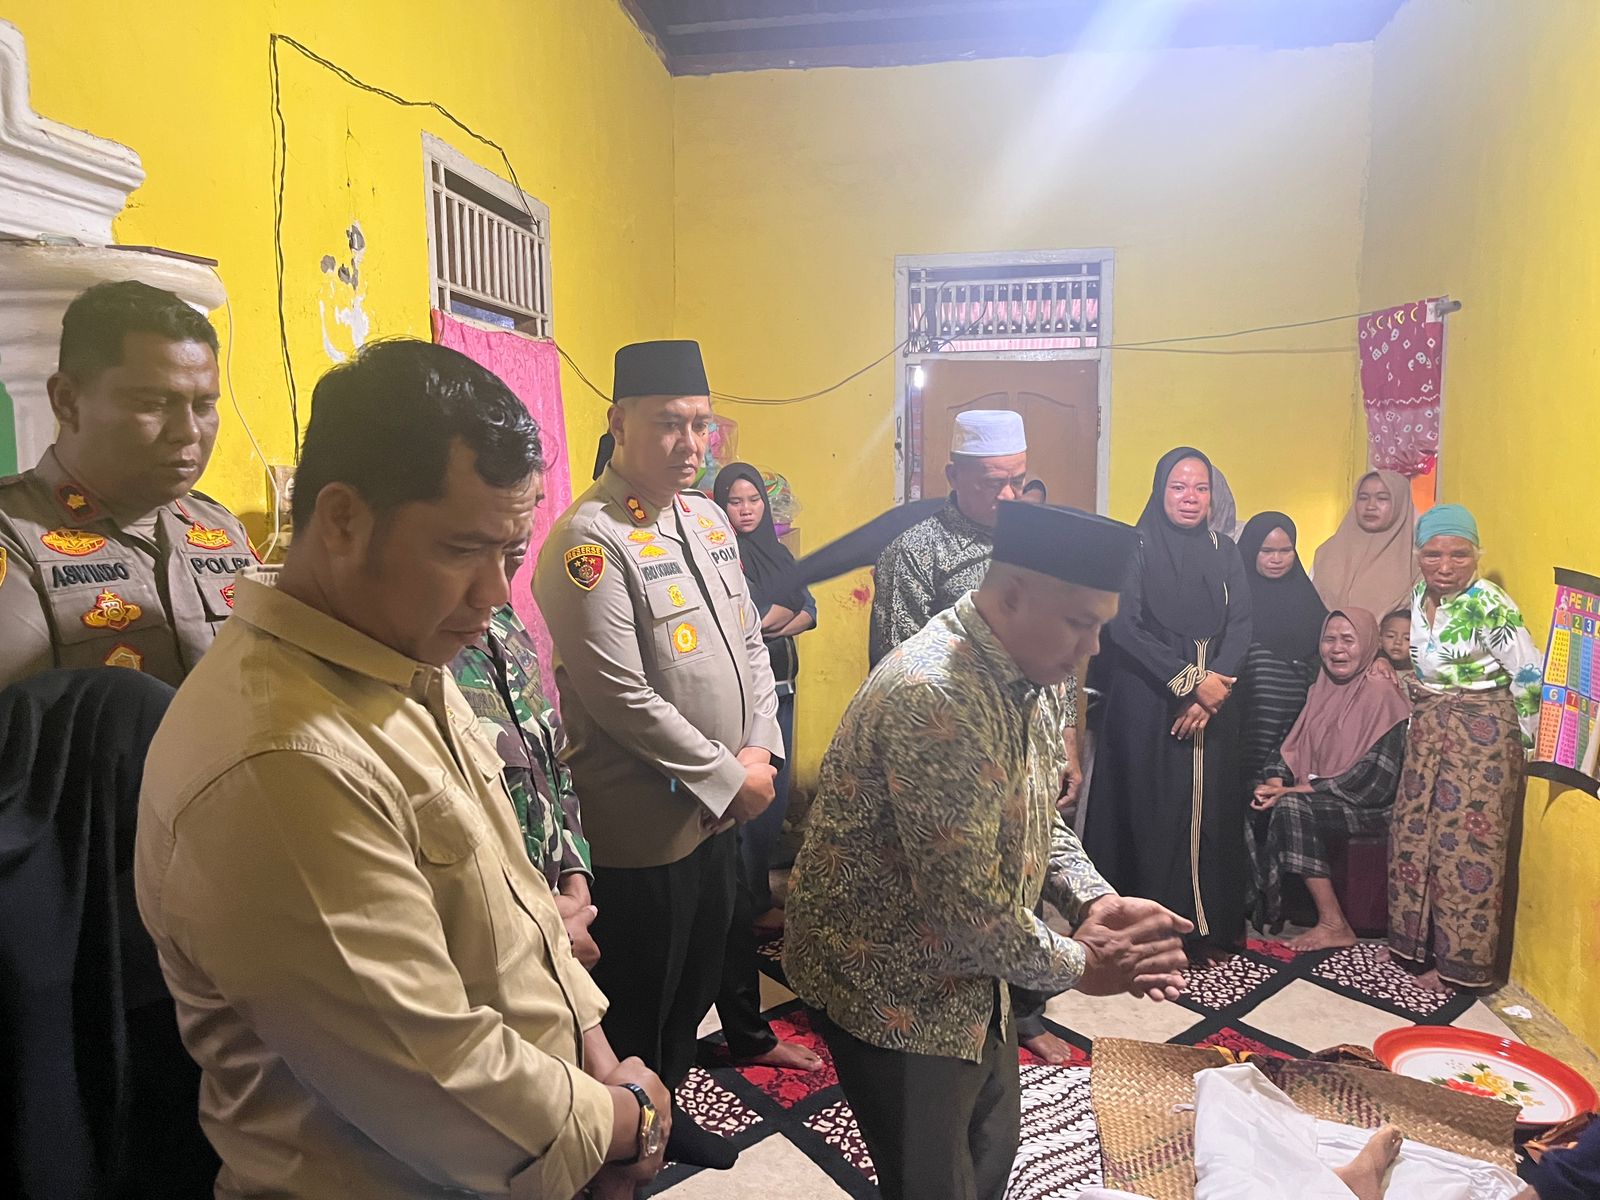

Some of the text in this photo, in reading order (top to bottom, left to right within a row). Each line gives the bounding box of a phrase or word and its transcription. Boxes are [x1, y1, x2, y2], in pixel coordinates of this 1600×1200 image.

[711, 546, 738, 564] POLR
[52, 562, 130, 588] ASWINDO
[1574, 616, 1580, 628] 2
[1586, 619, 1592, 632] 3
[1570, 693, 1576, 705] 7
